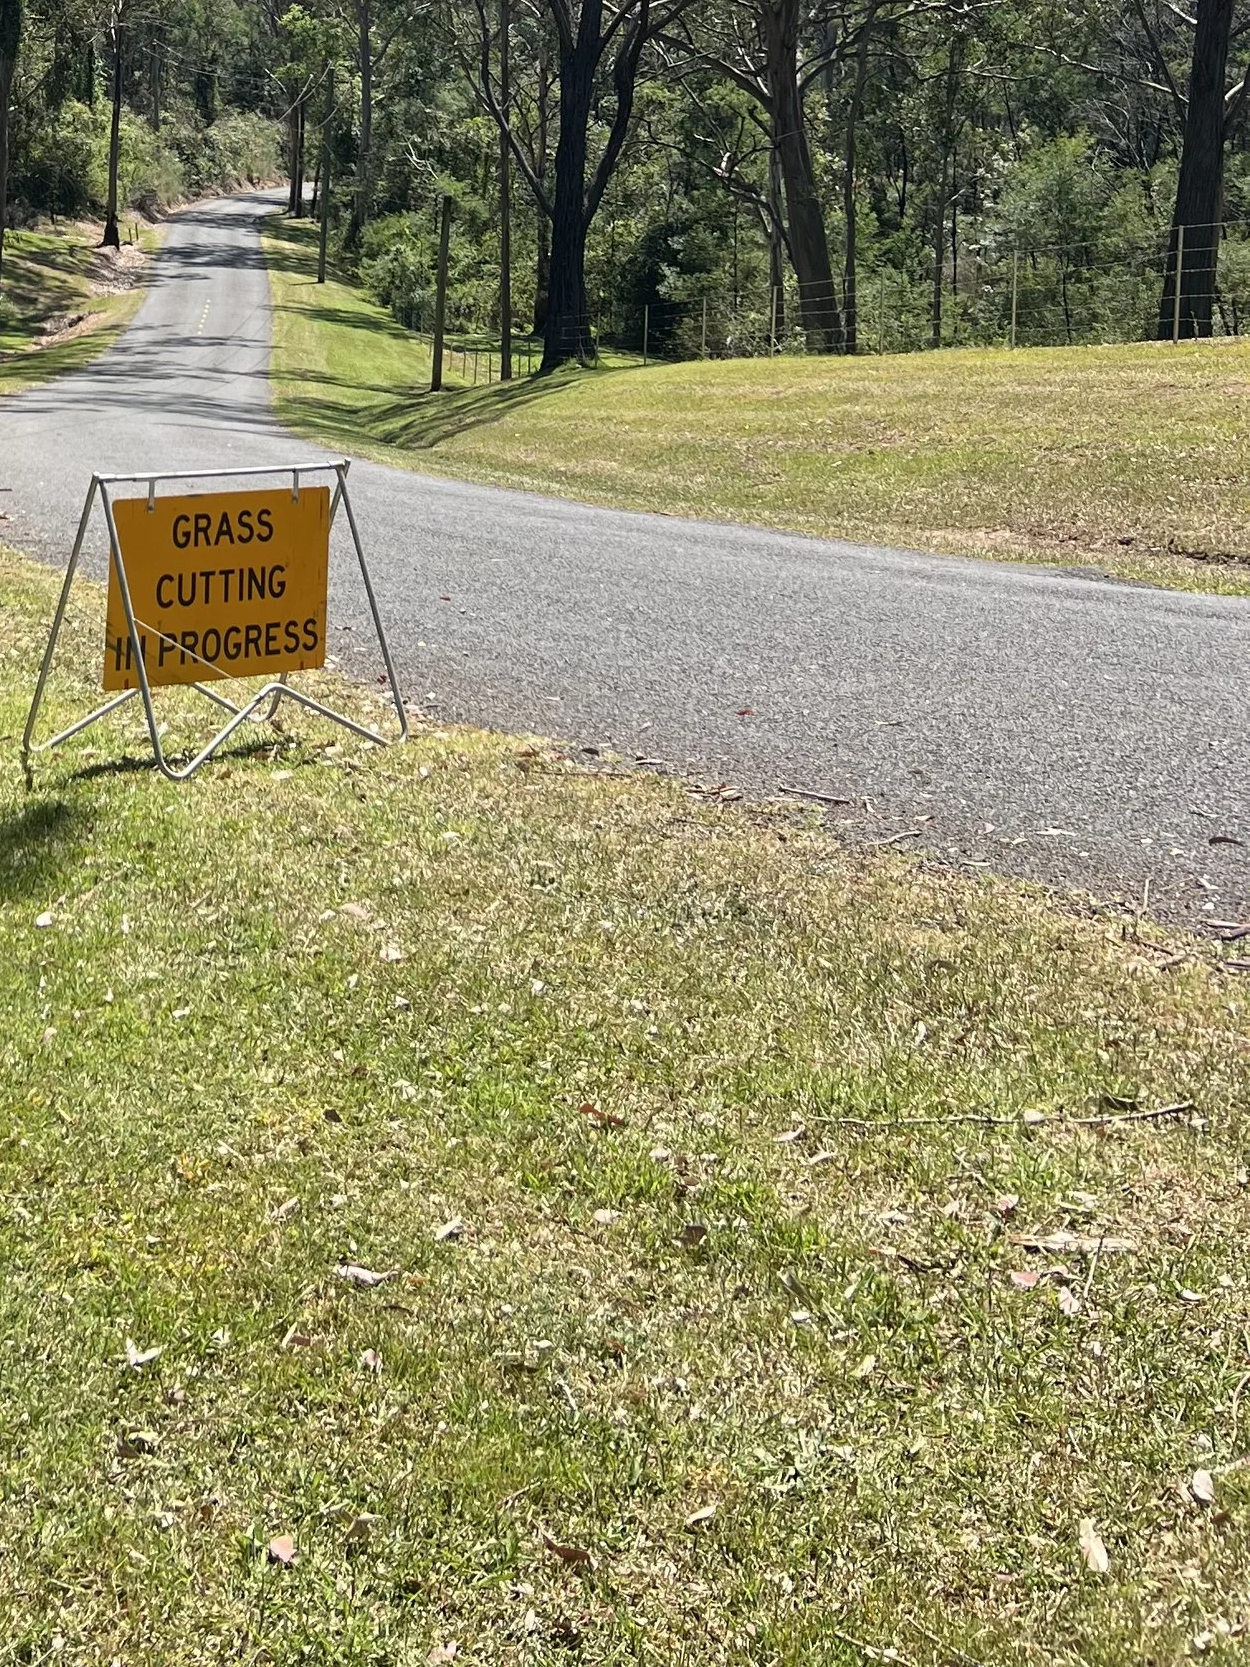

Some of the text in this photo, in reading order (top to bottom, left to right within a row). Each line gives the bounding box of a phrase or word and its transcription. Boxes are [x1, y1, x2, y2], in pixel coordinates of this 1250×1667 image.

[172, 508, 274, 549] GRASS
[156, 564, 287, 609] CUTTING
[115, 617, 319, 671] IN PROGRESS
